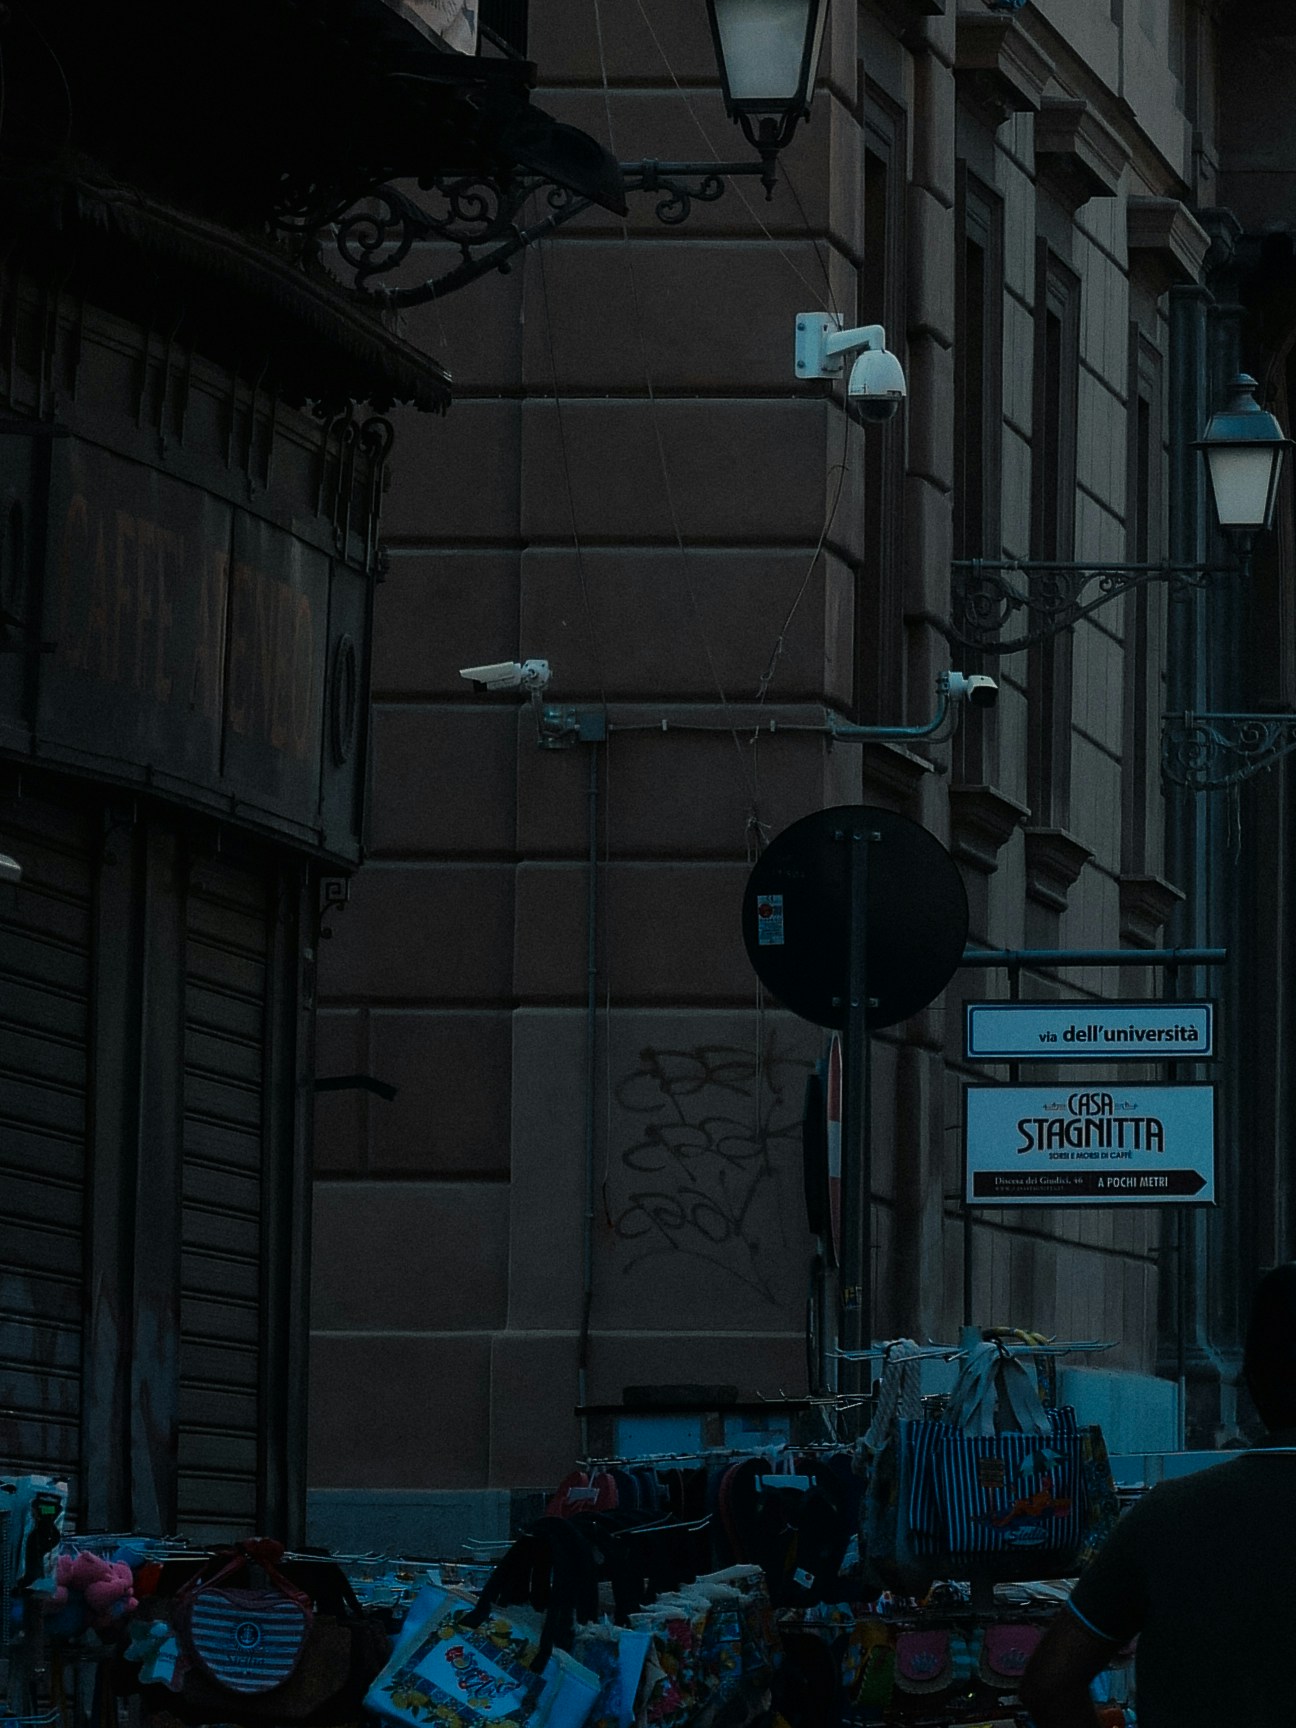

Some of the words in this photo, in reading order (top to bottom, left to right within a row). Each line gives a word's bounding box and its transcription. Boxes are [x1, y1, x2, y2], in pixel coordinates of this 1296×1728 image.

[1039, 1032, 1057, 1043] via
[1063, 1024, 1199, 1043] dell'università
[1068, 1093, 1113, 1116] CASA
[1017, 1117, 1165, 1154] STAGNITTA
[1098, 1177, 1105, 1189] A
[1107, 1176, 1136, 1189] POCHI
[1139, 1176, 1169, 1189] METRI
